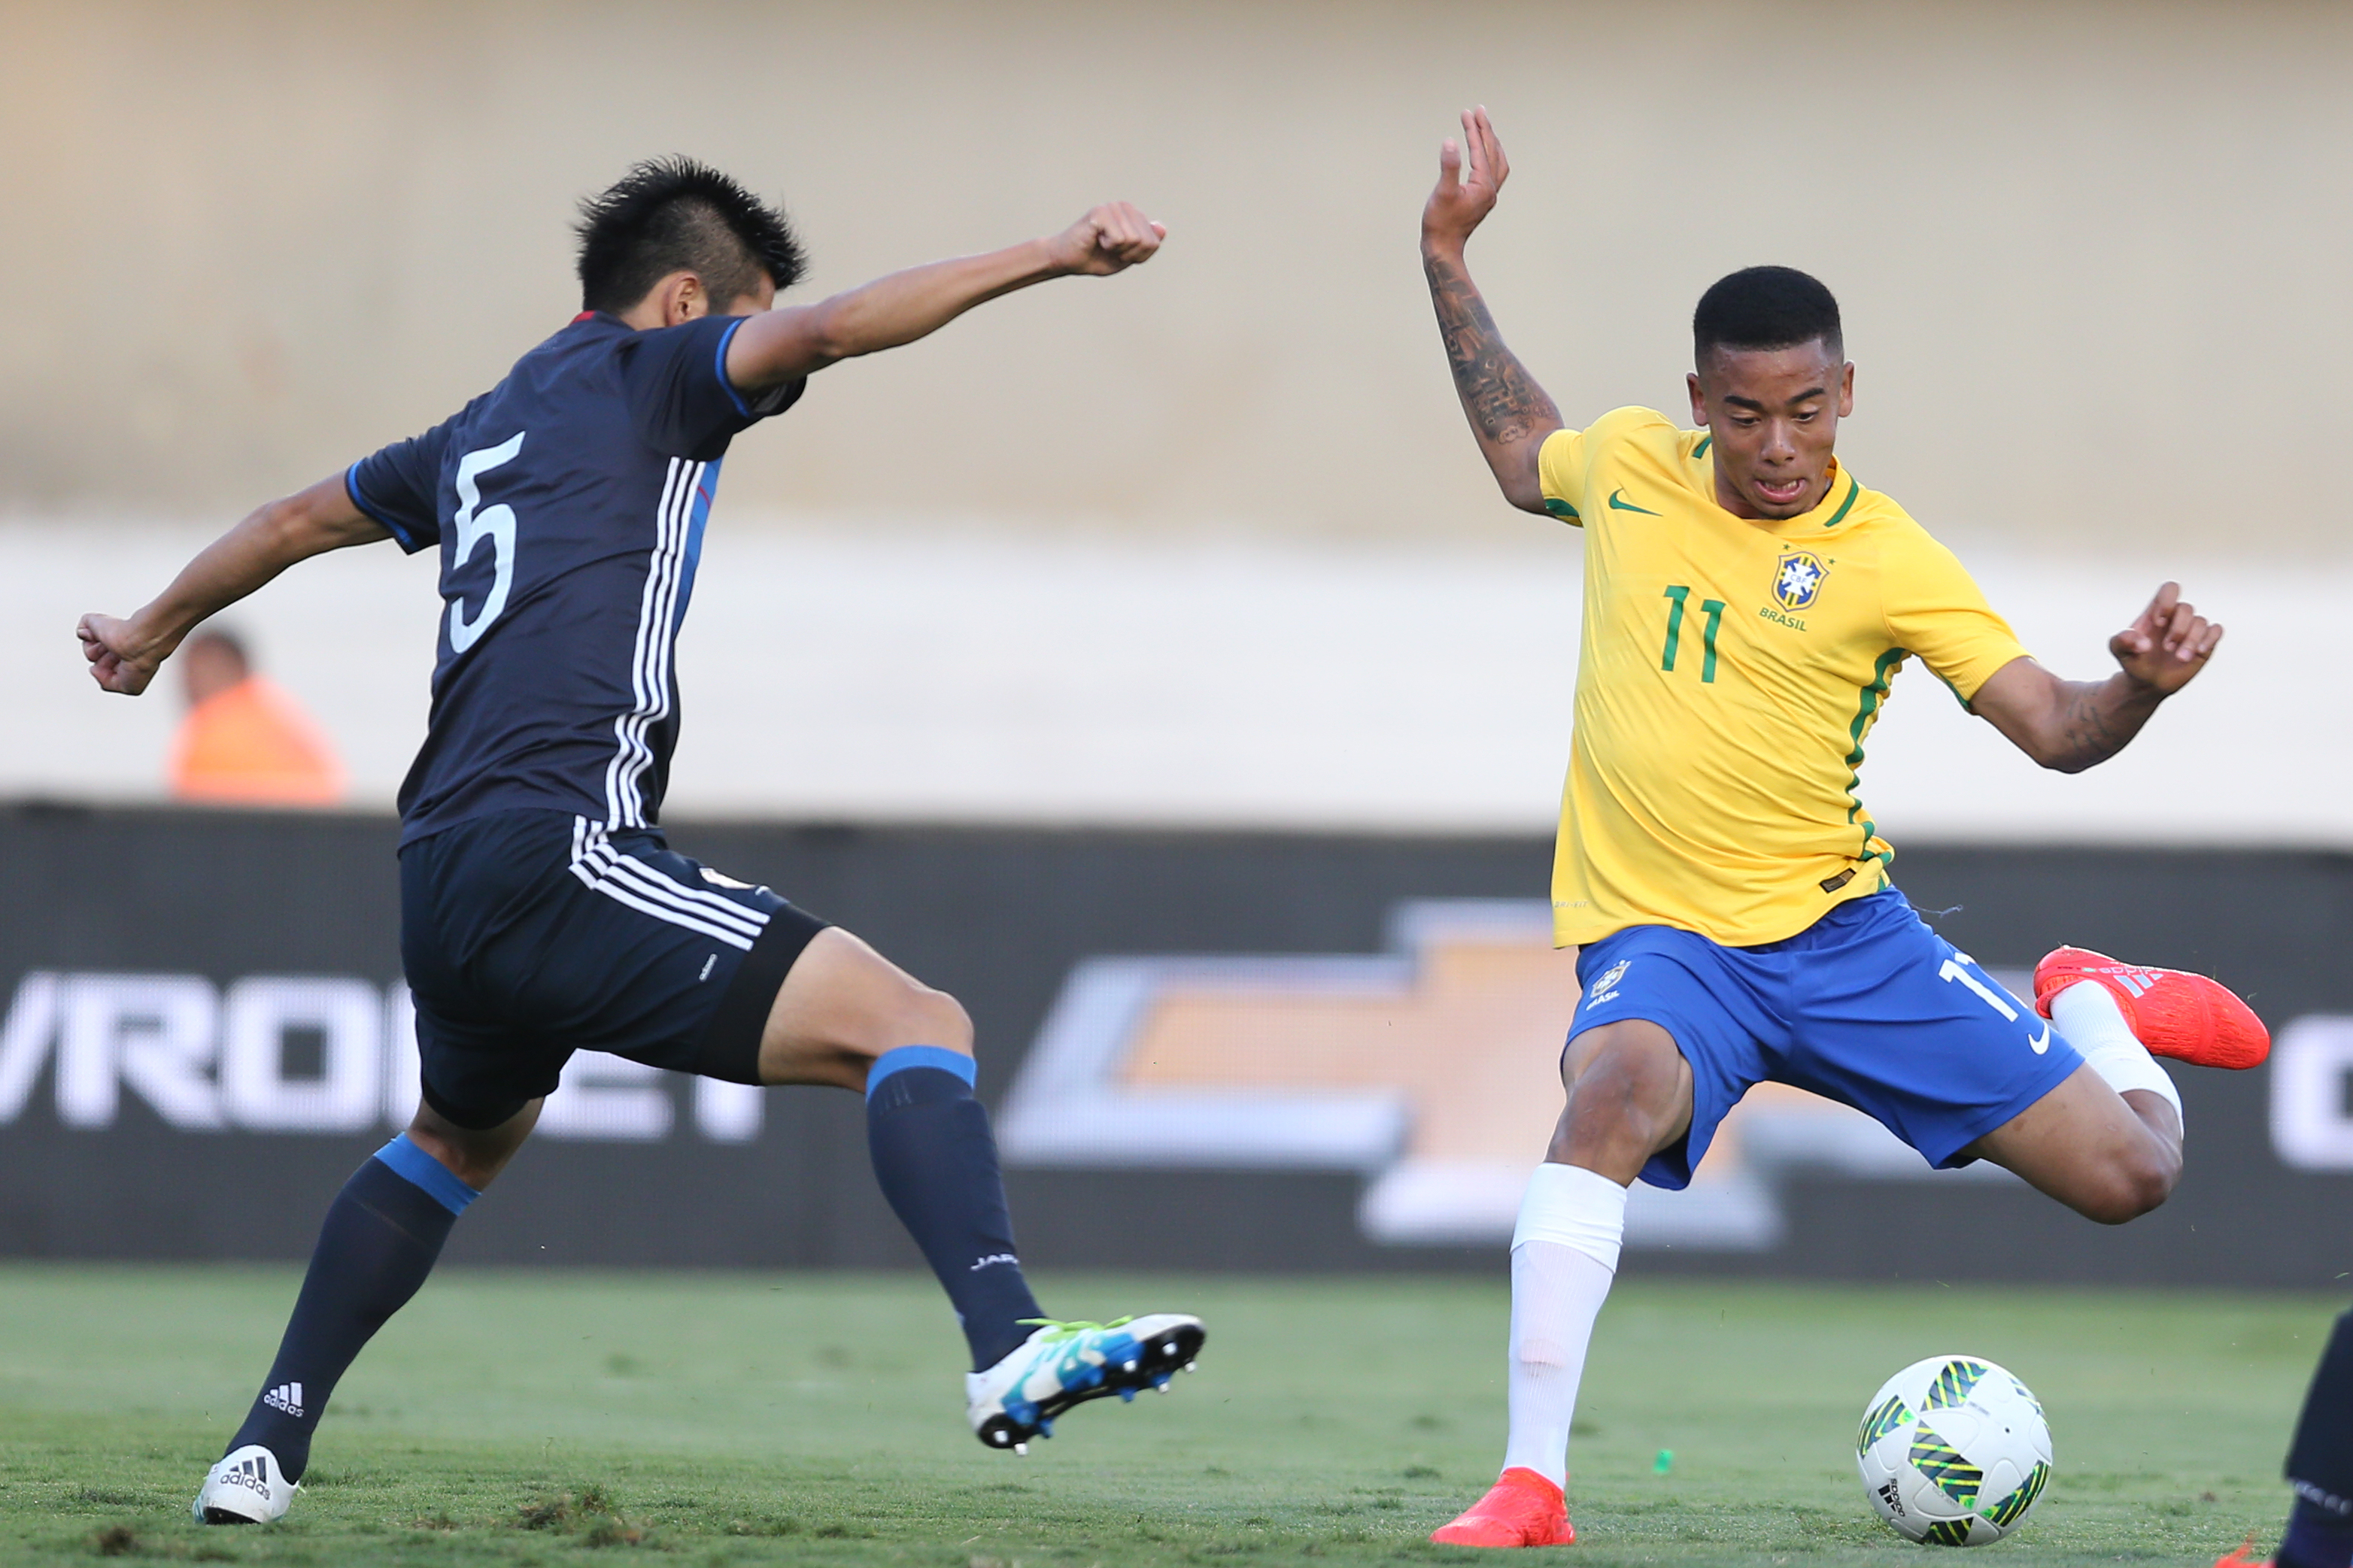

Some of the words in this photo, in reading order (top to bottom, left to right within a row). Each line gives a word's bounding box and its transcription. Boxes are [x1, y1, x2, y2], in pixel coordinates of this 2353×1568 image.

[449, 430, 526, 654] 5
[1790, 574, 1807, 584] CBF
[1759, 606, 1807, 632] BRASIL
[1662, 585, 1726, 683] 11
[263, 1394, 304, 1418] adidas
[220, 1472, 271, 1501] adidas
[1890, 1478, 1905, 1517] adidas
